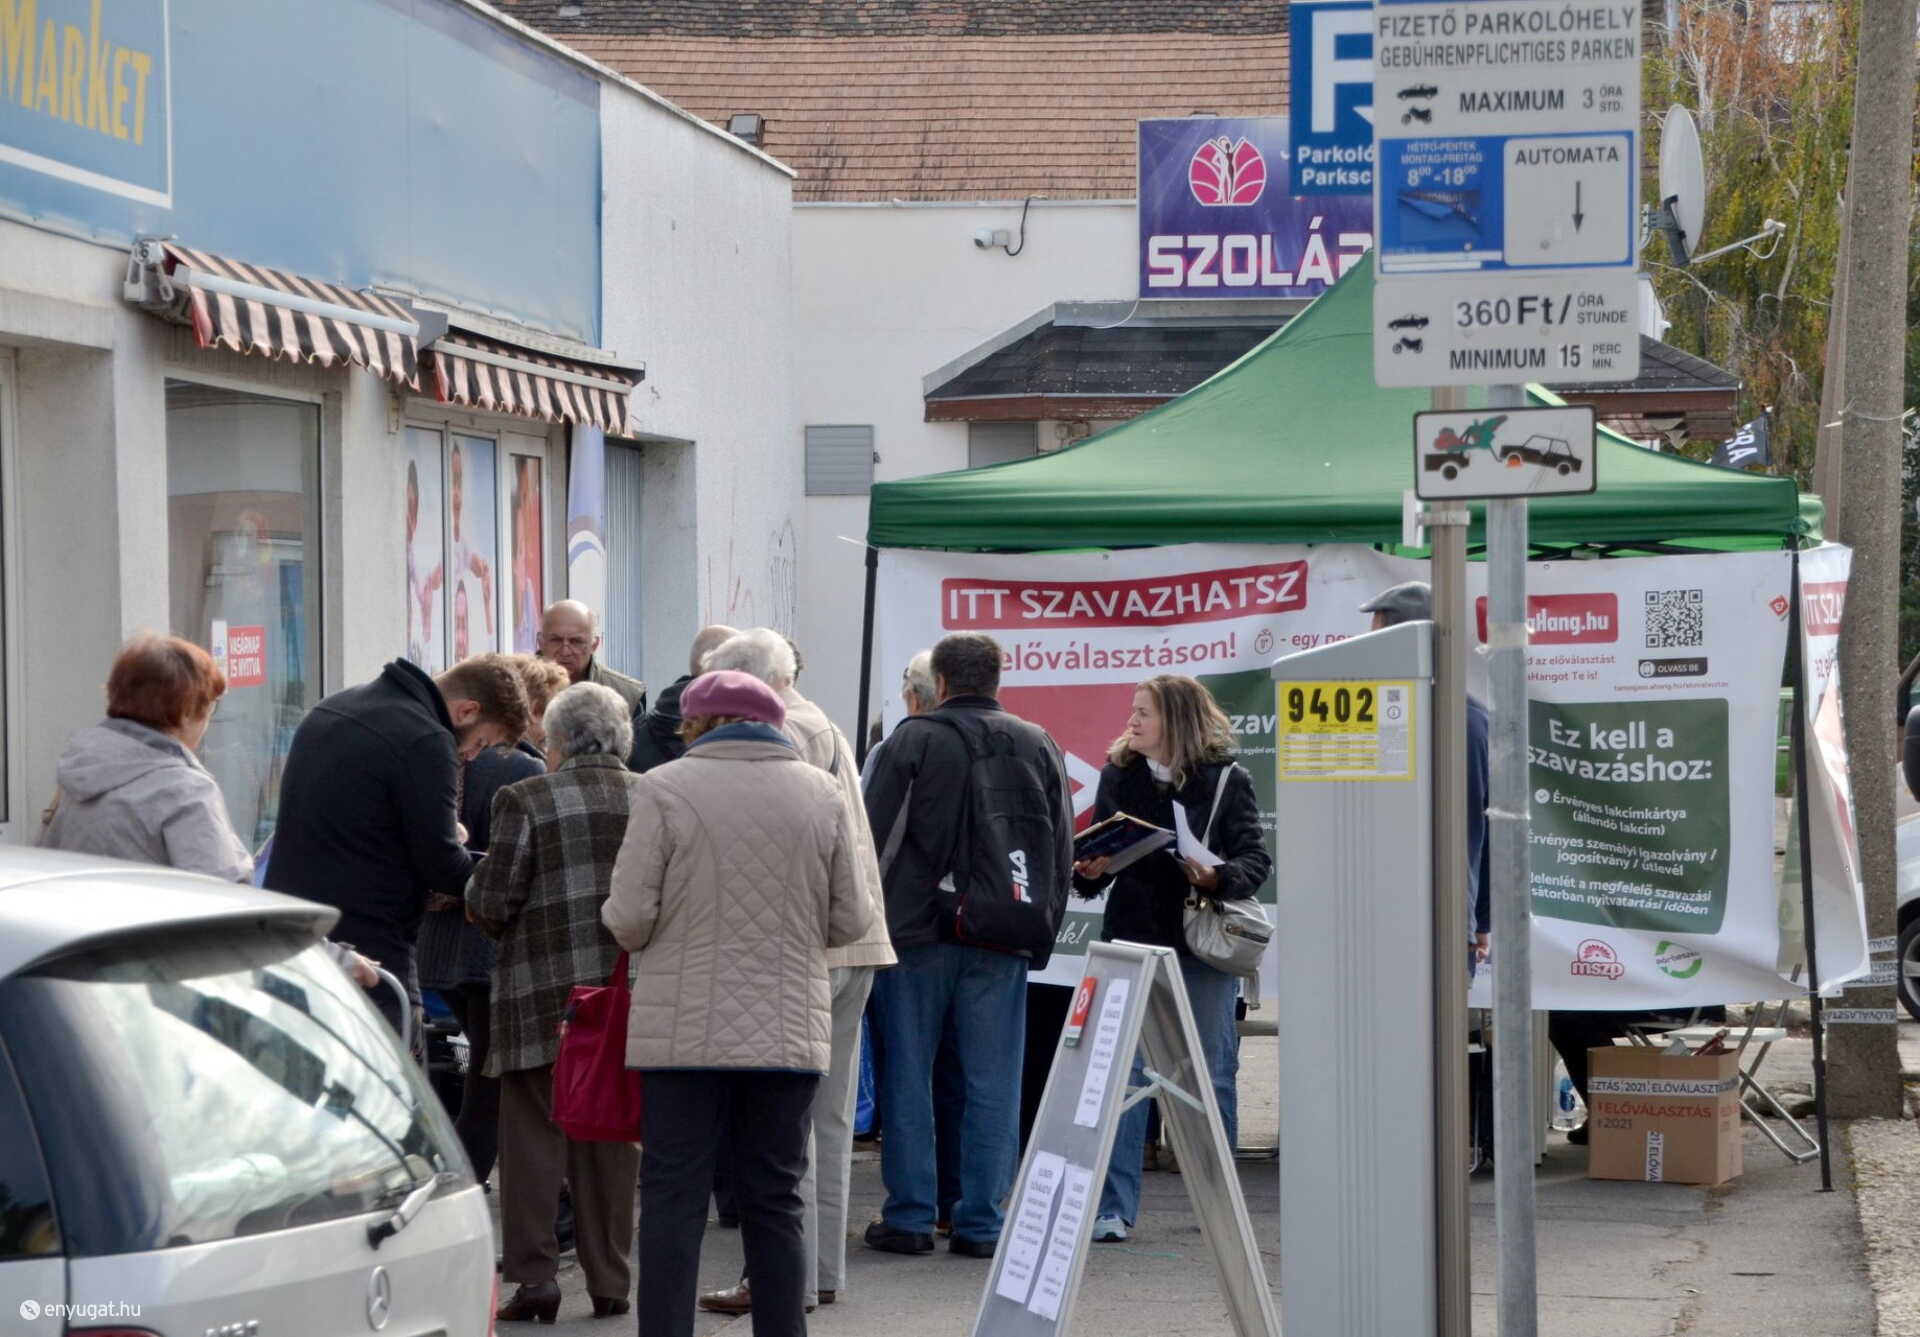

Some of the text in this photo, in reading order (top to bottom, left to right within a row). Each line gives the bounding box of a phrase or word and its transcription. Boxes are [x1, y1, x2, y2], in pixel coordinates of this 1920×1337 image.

[1379, 3, 1635, 37] FIZETŐ PARKOLÓHELY
[1380, 38, 1635, 68] GEBÜHRENPFLICHTIGES PARKEN
[1459, 88, 1594, 113] MAXIMUM 3
[1600, 84, 1623, 98] ÓRA
[1514, 146, 1620, 166] AUTOMATA
[1577, 293, 1604, 307] ÓRA
[1577, 310, 1628, 324] STUNDE
[1450, 344, 1581, 370] MINIMUM 15
[1592, 343, 1621, 355] PERC
[950, 570, 1299, 620] ITT SZAVAZHATSZ
[1000, 631, 1236, 672] előválasztáson!
[1292, 633, 1319, 650] egy
[1657, 664, 1688, 673] OLVASS
[1288, 687, 1373, 723] 9402
[1549, 718, 1673, 749] Ez kell a
[1528, 746, 1713, 782] szavazáshoz:
[1553, 789, 1687, 822] Érvényes lakcímkártya
[1556, 850, 1630, 870] jogosítvány
[1586, 839, 1636, 857] személyi
[1639, 847, 1707, 864] igazolvány
[1009, 850, 1032, 903] FILA
[1531, 885, 1709, 915] sátorban nyitvatartási időben
[1589, 881, 1652, 897] megfelelő
[1654, 888, 1712, 902] szavazási
[1572, 961, 1624, 980] mszp
[1604, 1102, 1712, 1118] ELŐVÁLASZTÁS
